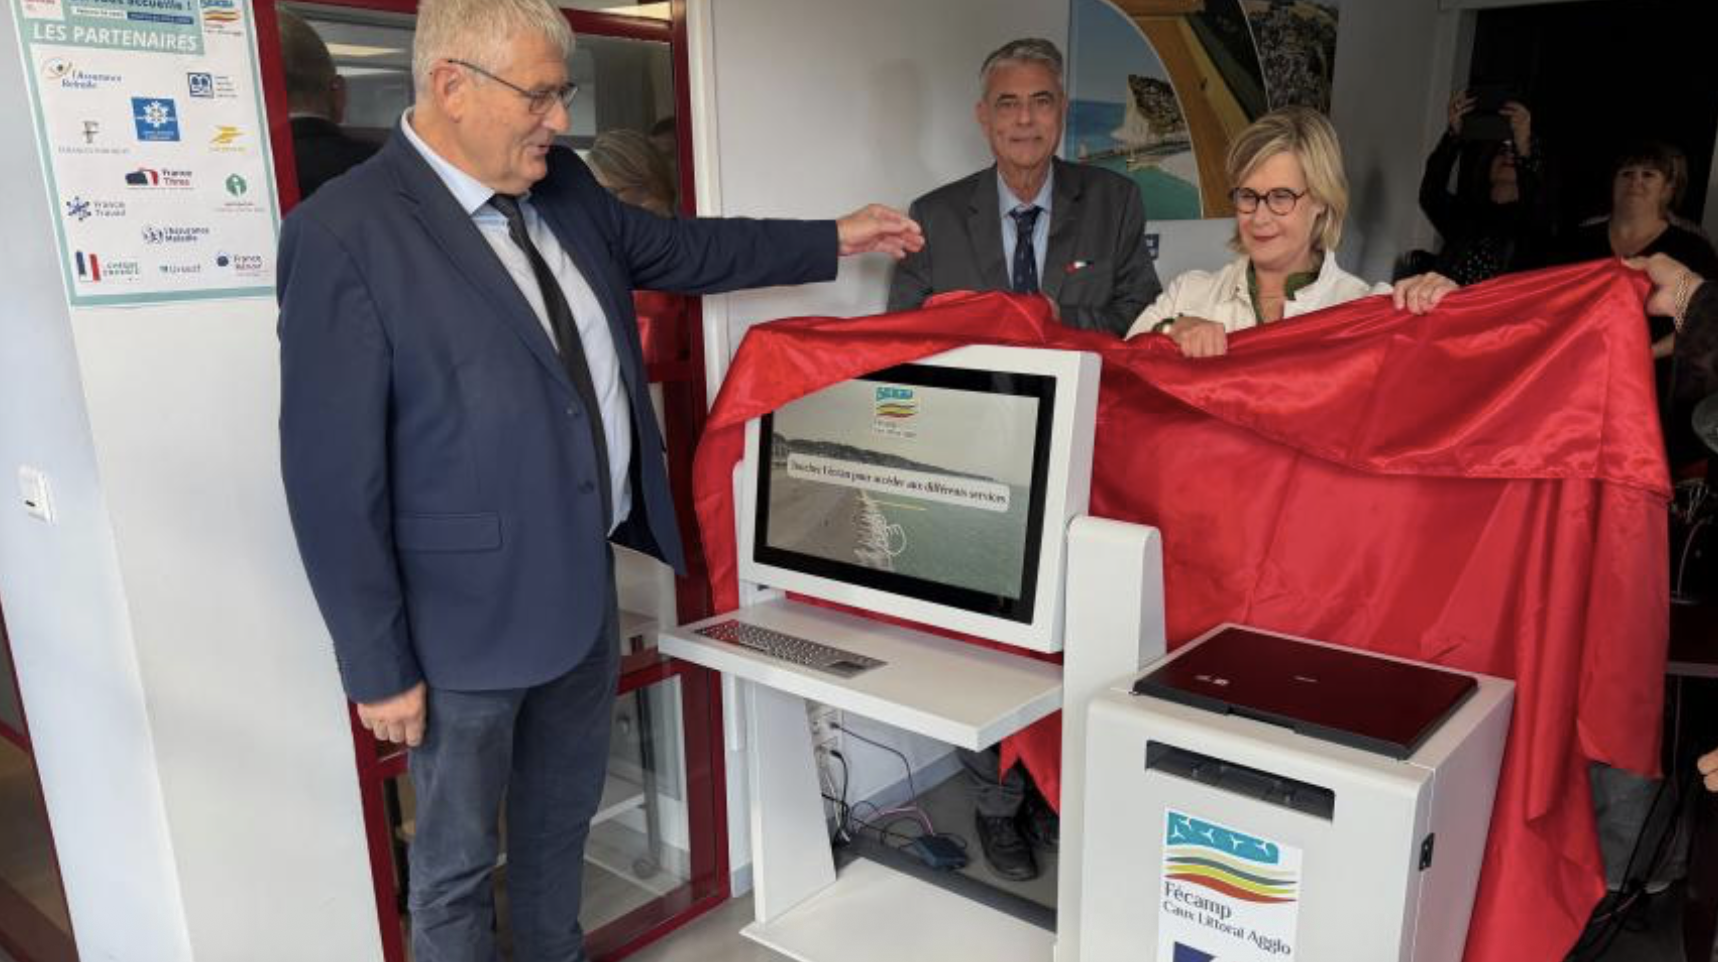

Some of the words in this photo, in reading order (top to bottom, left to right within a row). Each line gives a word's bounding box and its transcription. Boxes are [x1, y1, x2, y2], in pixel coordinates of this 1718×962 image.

[33, 23, 67, 41] LES
[73, 26, 198, 51] PARTENAIRES
[1164, 881, 1232, 920] Fécamp
[1163, 901, 1195, 920] Caux
[1198, 912, 1245, 939] Littoral
[1247, 930, 1291, 955] Agglo
